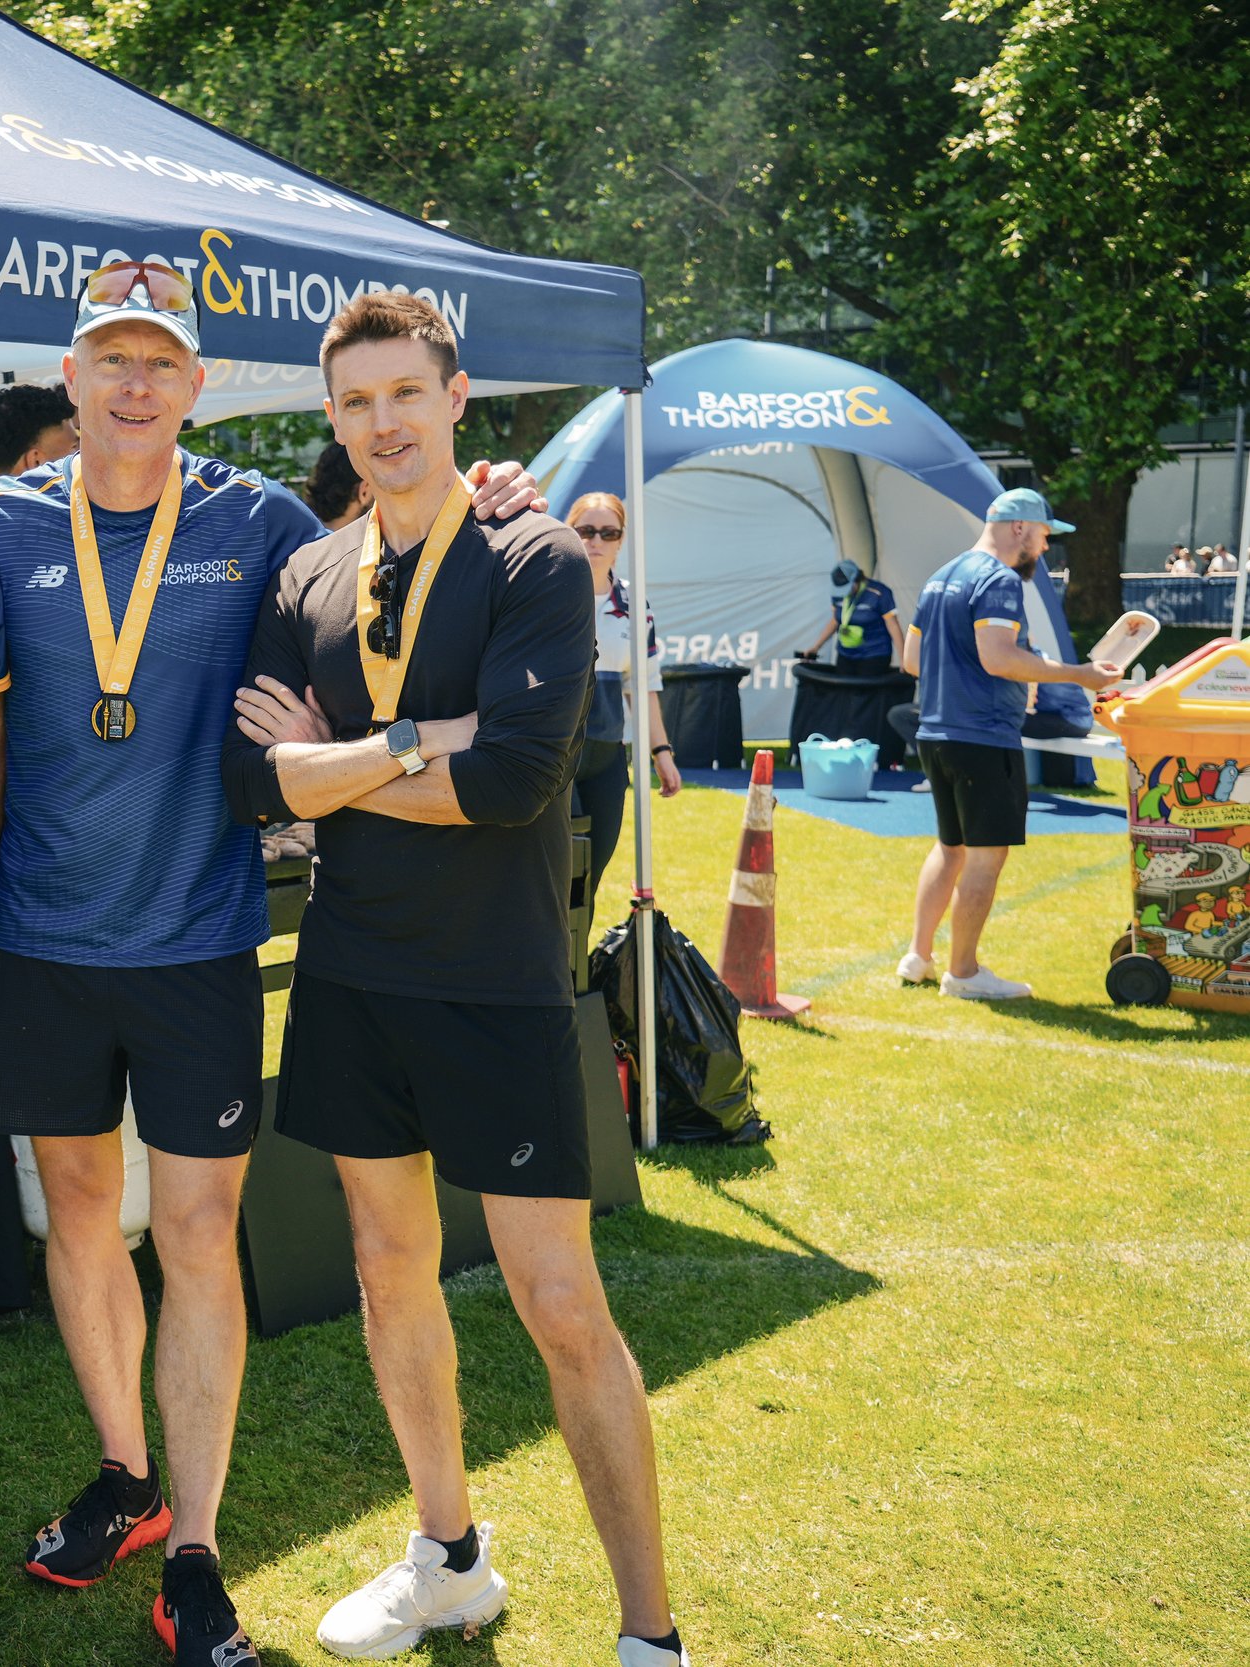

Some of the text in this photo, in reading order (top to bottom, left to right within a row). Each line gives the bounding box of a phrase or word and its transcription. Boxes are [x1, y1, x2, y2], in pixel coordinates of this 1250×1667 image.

[698, 388, 846, 410] BARFOOT
[661, 406, 847, 429] THOMPSON
[75, 487, 88, 539] GARMIN
[141, 534, 165, 589] GARMIN
[167, 560, 228, 574] BARFOOT
[159, 571, 226, 585] HOMPSON
[408, 560, 434, 617] GARMIN
[102, 1463, 121, 1472] aucony
